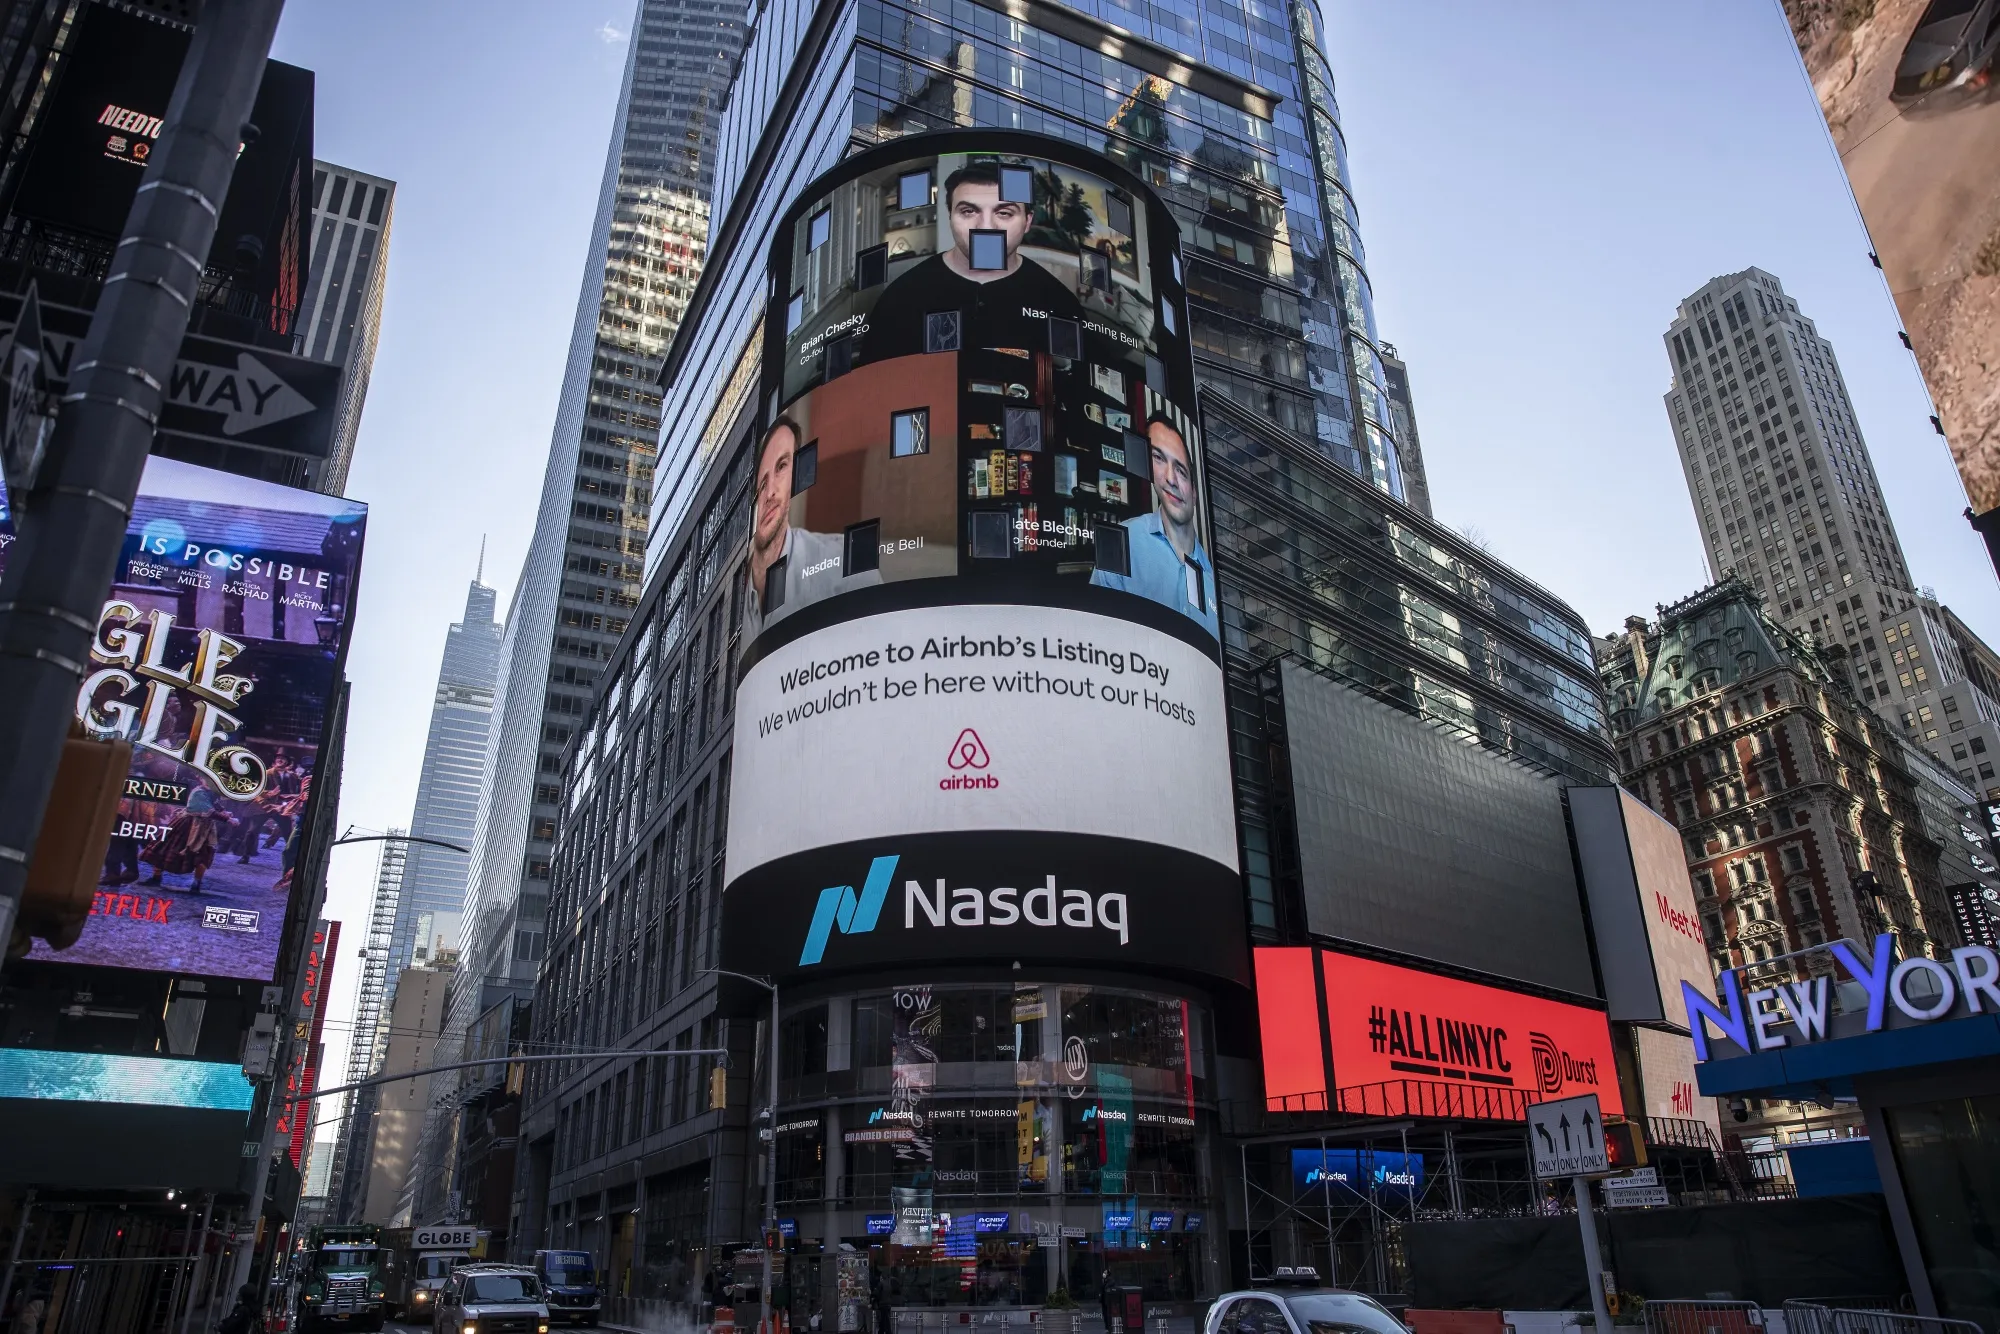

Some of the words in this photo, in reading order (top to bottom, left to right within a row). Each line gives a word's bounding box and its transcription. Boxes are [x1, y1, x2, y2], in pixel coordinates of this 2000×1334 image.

[801, 333, 824, 354] Brian
[825, 313, 866, 339] Chesky
[1120, 332, 1138, 349] Bell
[170, 363, 282, 416] WAY
[898, 536, 924, 551] Bell
[128, 559, 150, 568] ANIKA
[151, 564, 169, 572] NONI
[139, 535, 168, 555] IS
[184, 544, 331, 590] POSSIBLE
[801, 556, 841, 579] Nasdaq
[131, 567, 163, 580] ROSE
[180, 570, 212, 581] MADALEN
[177, 577, 212, 589] MILLS
[233, 580, 261, 591] PHYLICIA
[221, 583, 269, 601] RASHAD
[294, 592, 313, 601] RICKY
[279, 595, 324, 612] MARTIN
[780, 648, 880, 695] Welcome
[886, 643, 915, 664] to
[920, 635, 1036, 660] Airbnb's
[1042, 637, 1125, 674] Listing
[1130, 652, 1170, 686] Day
[759, 709, 783, 739] We
[786, 679, 879, 724] wouldn't
[884, 673, 917, 700] be
[924, 672, 986, 696] here
[992, 670, 1095, 700] without
[1100, 684, 1139, 708] our
[1144, 688, 1197, 729] Hosts
[939, 773, 999, 792] airbnb
[905, 874, 1129, 945] Nasdaq
[1656, 890, 1692, 939] Meet
[205, 912, 227, 924] PG
[1680, 969, 1828, 1062] NEW
[1368, 1005, 1513, 1073] #ALLINNYC
[1562, 1051, 1599, 1086] Durst
[1671, 1081, 1693, 1117] H&M
[883, 1110, 914, 1122] Nasdaq
[928, 1110, 966, 1118] REWRITE
[970, 1109, 1020, 1118] TOMORROW
[1097, 1110, 1127, 1122] Nasdaq
[1138, 1113, 1166, 1123] REWRITE
[789, 1119, 819, 1130] TOMORROW
[845, 1129, 882, 1142] BRANDED
[883, 1129, 913, 1140] CITIES
[1538, 1159, 1557, 1173] ONLY
[1560, 1157, 1579, 1171] ONLY
[1583, 1154, 1604, 1167] ONLY
[933, 1169, 979, 1183] Nasdaq
[1319, 1172, 1347, 1181] Nasdaq
[1386, 1172, 1415, 1188] Nasdaq
[418, 1232, 471, 1245] GLOBE
